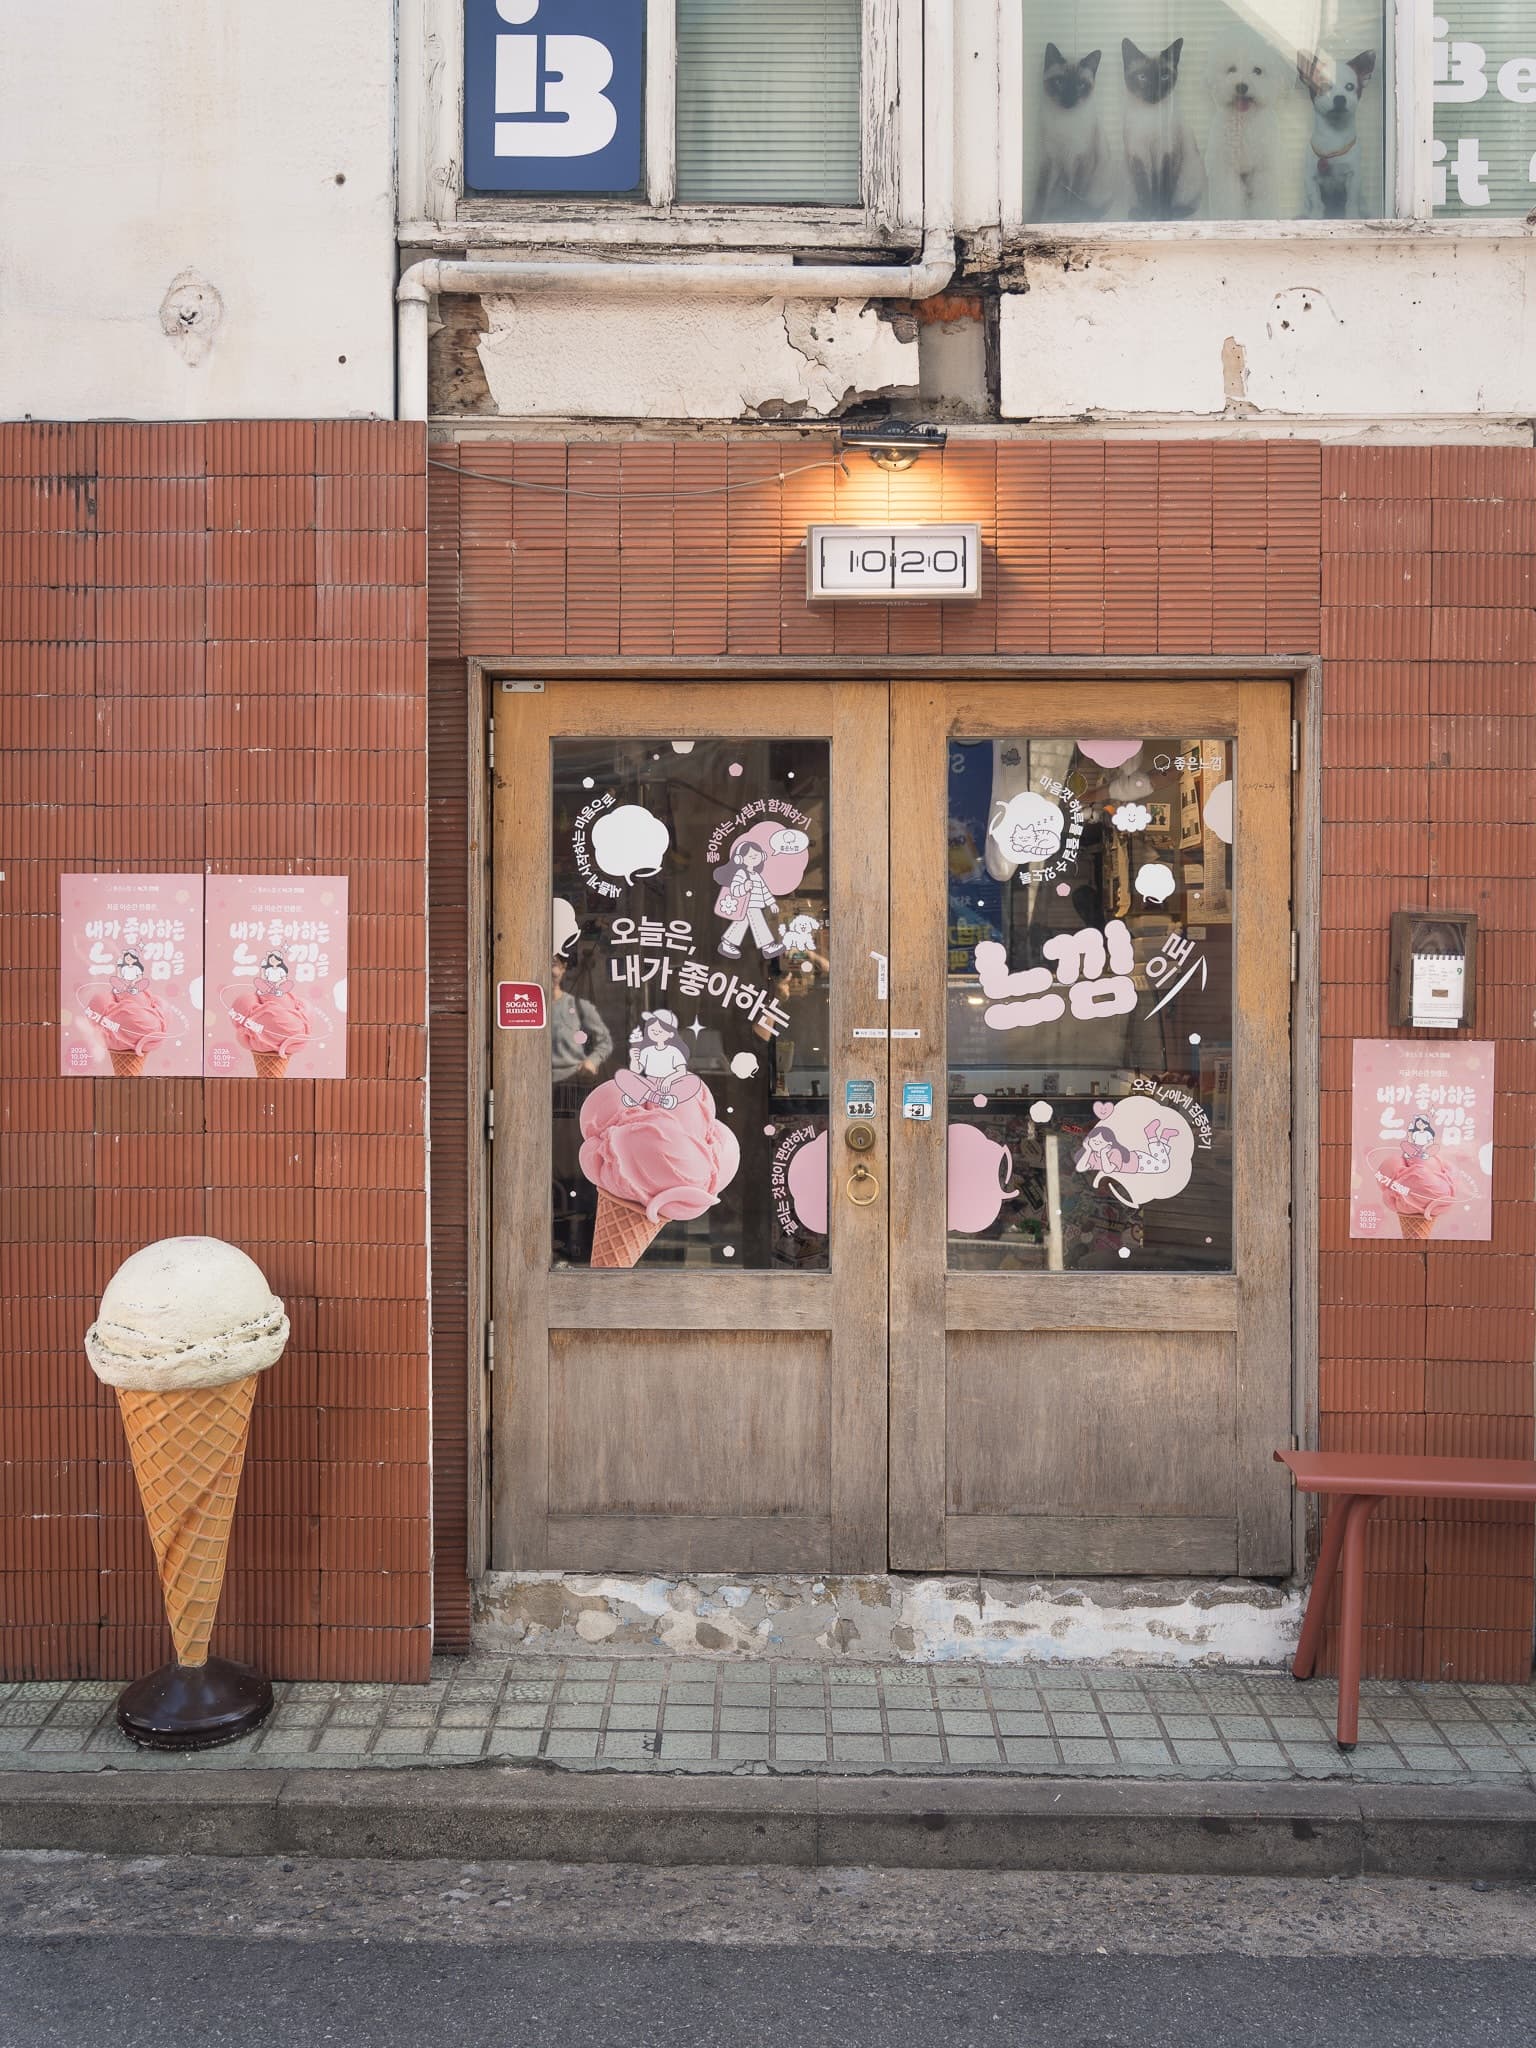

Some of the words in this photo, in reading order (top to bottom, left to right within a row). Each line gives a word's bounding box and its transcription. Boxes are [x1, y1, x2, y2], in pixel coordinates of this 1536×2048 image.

[1174, 756, 1222, 771] 좋은느낌
[1040, 776, 1074, 803] 마음껏
[574, 793, 616, 829] 마음으로
[1068, 799, 1084, 836] 하루를
[706, 820, 735, 863] 좋아하는
[735, 799, 766, 826] 사람과
[768, 799, 812, 831] 함께하기
[572, 830, 593, 876] 시작하는
[1062, 838, 1080, 863] 즐길
[1020, 866, 1056, 885] 있도록
[1056, 861, 1067, 872] 수
[586, 873, 622, 898] 새롭게
[85, 919, 121, 940] 내가
[123, 917, 184, 945] 좋아하는
[230, 920, 265, 941] 내가
[267, 919, 330, 946] 좋아하는
[611, 916, 696, 955] 오늘은,
[611, 954, 672, 990] 내가
[678, 960, 790, 1037] 좋아하는
[1376, 1085, 1413, 1105] 내가
[1414, 1083, 1476, 1110] 좋아하는
[1132, 1079, 1157, 1095] 오직
[1157, 1086, 1193, 1109] 나에게
[1188, 1102, 1213, 1149] 집중하기
[776, 1124, 816, 1161] 편안하게
[771, 1162, 787, 1185] 없이
[771, 1186, 787, 1199] 것
[776, 1200, 799, 1236] 걸리는
